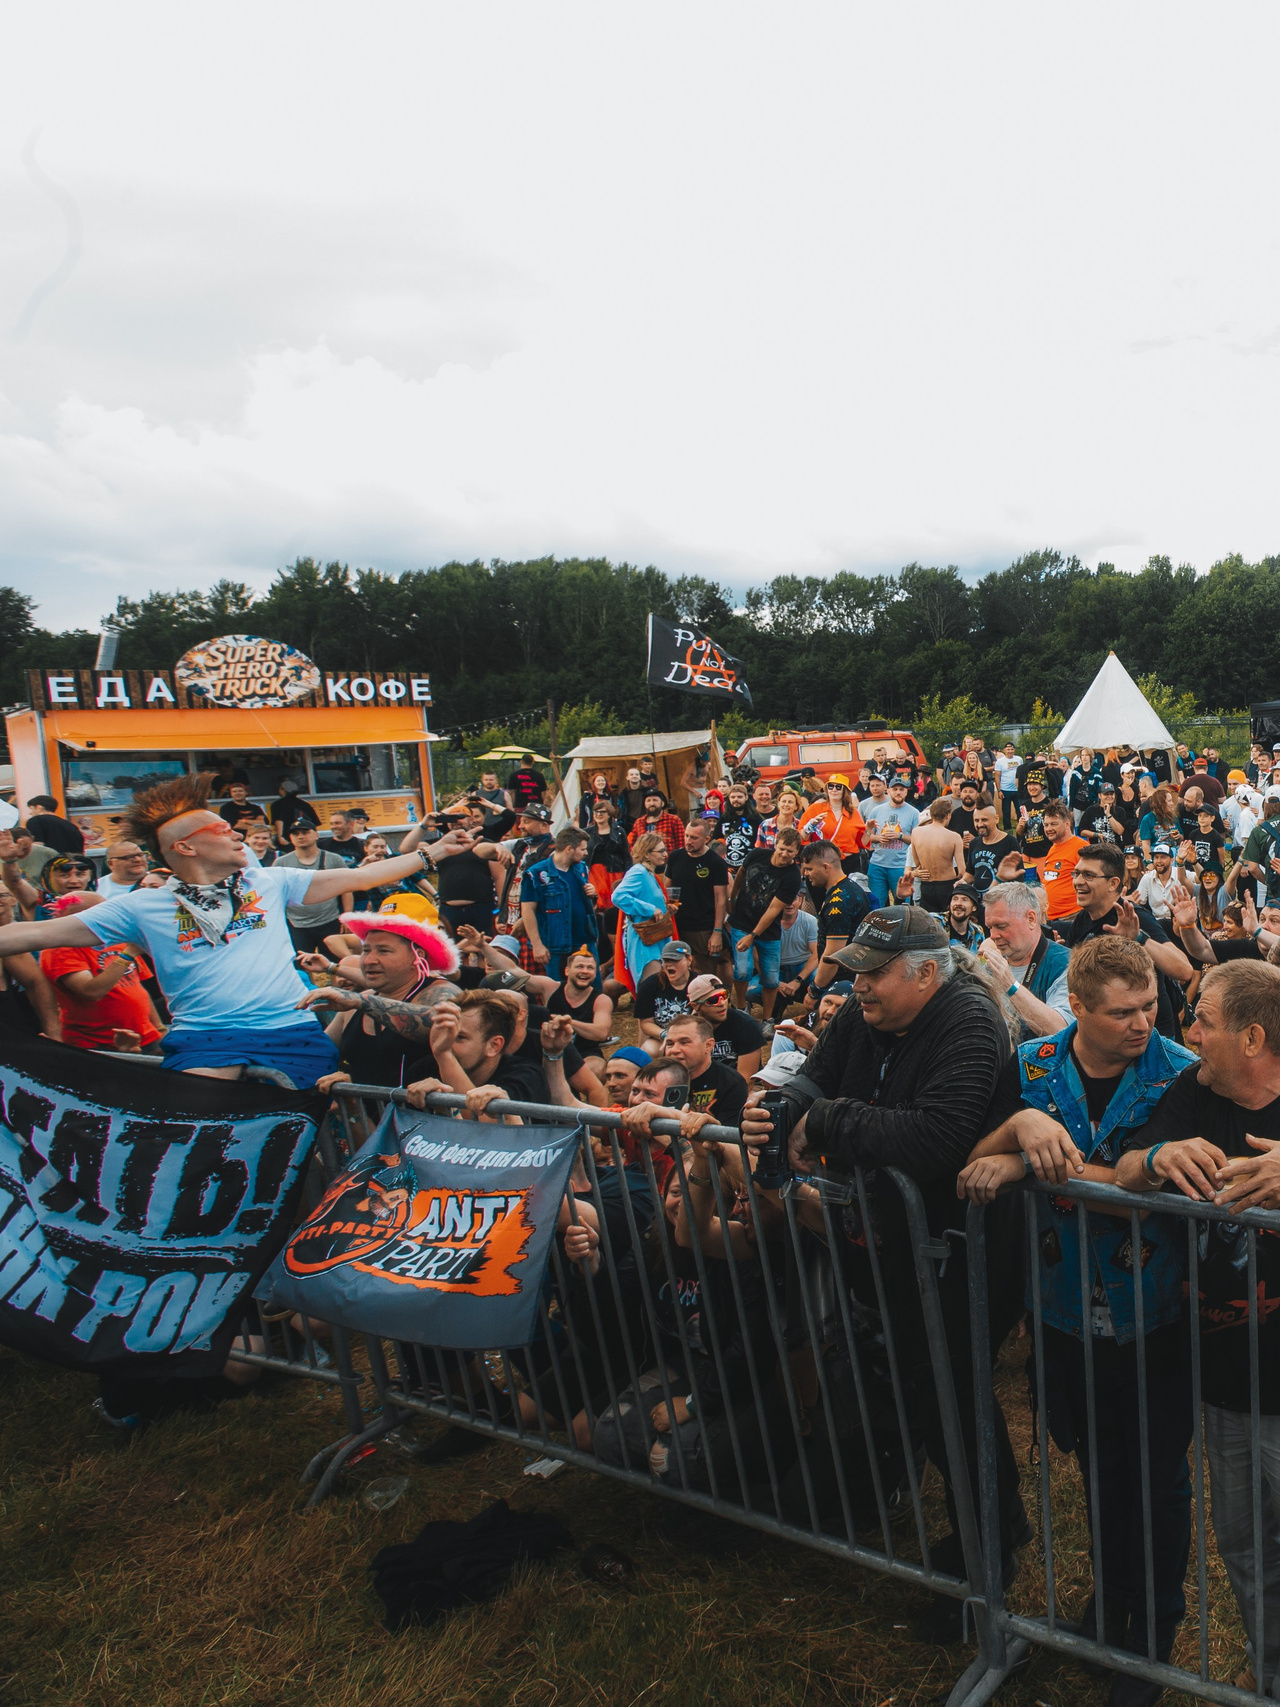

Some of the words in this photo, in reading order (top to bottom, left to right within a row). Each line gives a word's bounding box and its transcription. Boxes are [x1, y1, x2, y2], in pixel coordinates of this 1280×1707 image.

[205, 642, 283, 668] SUPER
[699, 657, 726, 671] Not
[219, 660, 277, 680] HERO
[48, 677, 176, 708] ЕДА
[209, 675, 288, 700] TRUCK
[326, 677, 432, 702] КОФЕ
